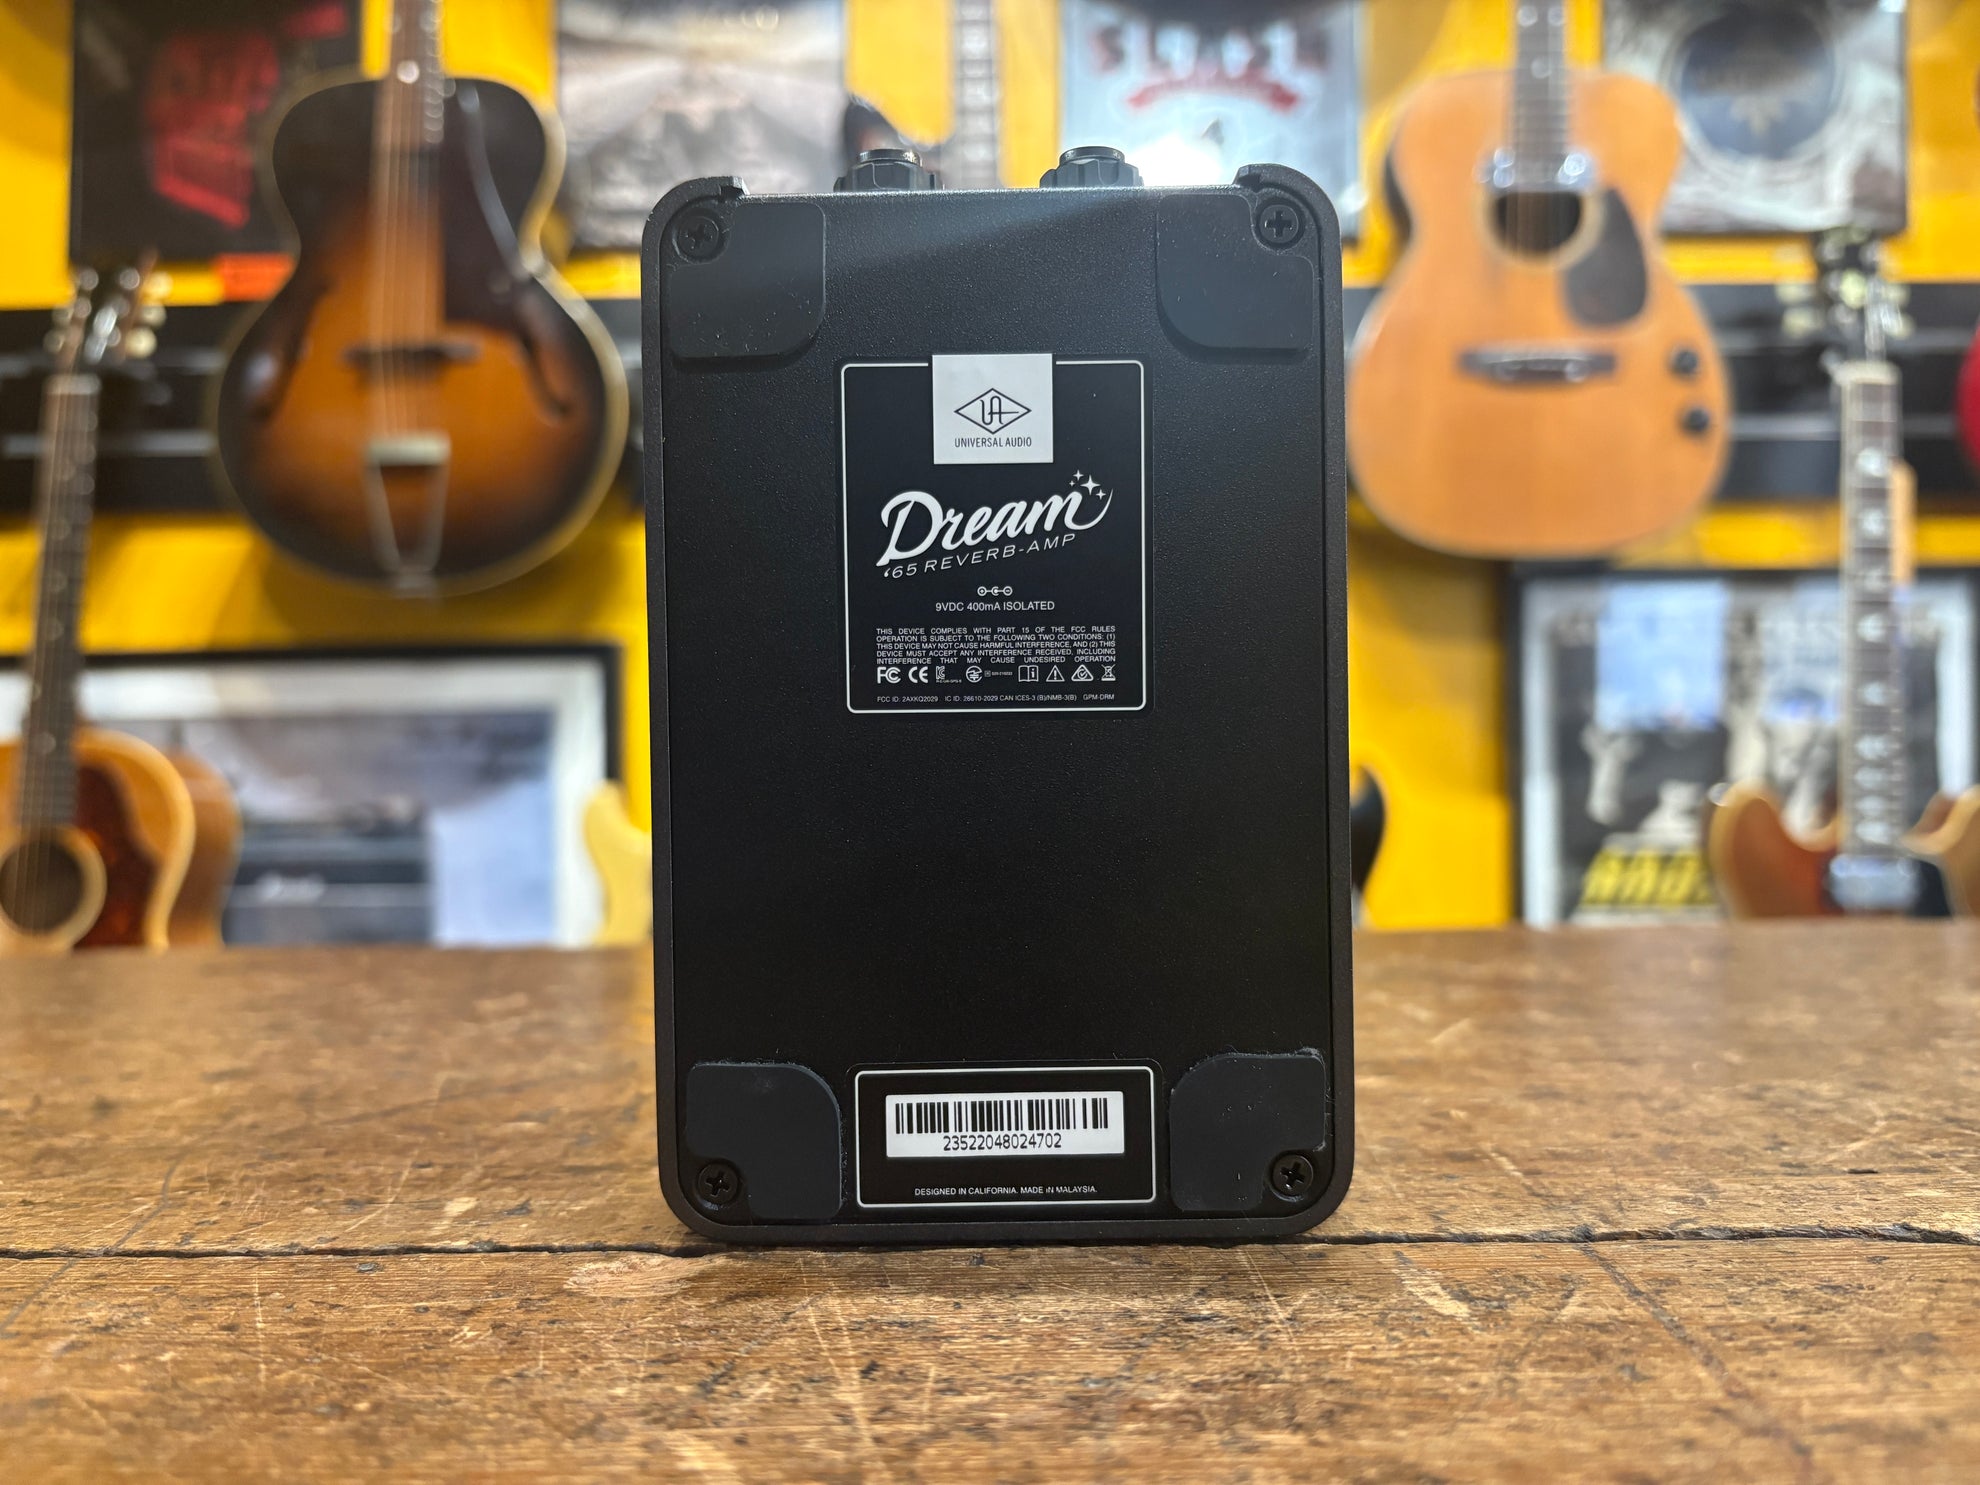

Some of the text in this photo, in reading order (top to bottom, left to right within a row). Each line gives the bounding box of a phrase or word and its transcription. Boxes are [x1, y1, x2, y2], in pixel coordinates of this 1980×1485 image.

[954, 436, 1032, 448] UNIVERSAL AUDIO
[876, 488, 1114, 567] Dream
[923, 533, 1076, 573] REVERB-AMP
[935, 601, 1055, 612] 9VDC 400mA ISOLATED
[1015, 641, 1072, 649] INTERFERENCE,
[908, 665, 929, 684] CE
[943, 1132, 1062, 1151] 23522048024702
[915, 1187, 957, 1196] DESIGNED
[958, 1187, 967, 1195] IN
[968, 1186, 1018, 1195] CALIFORNIA.
[1020, 1186, 1043, 1194] MADE
